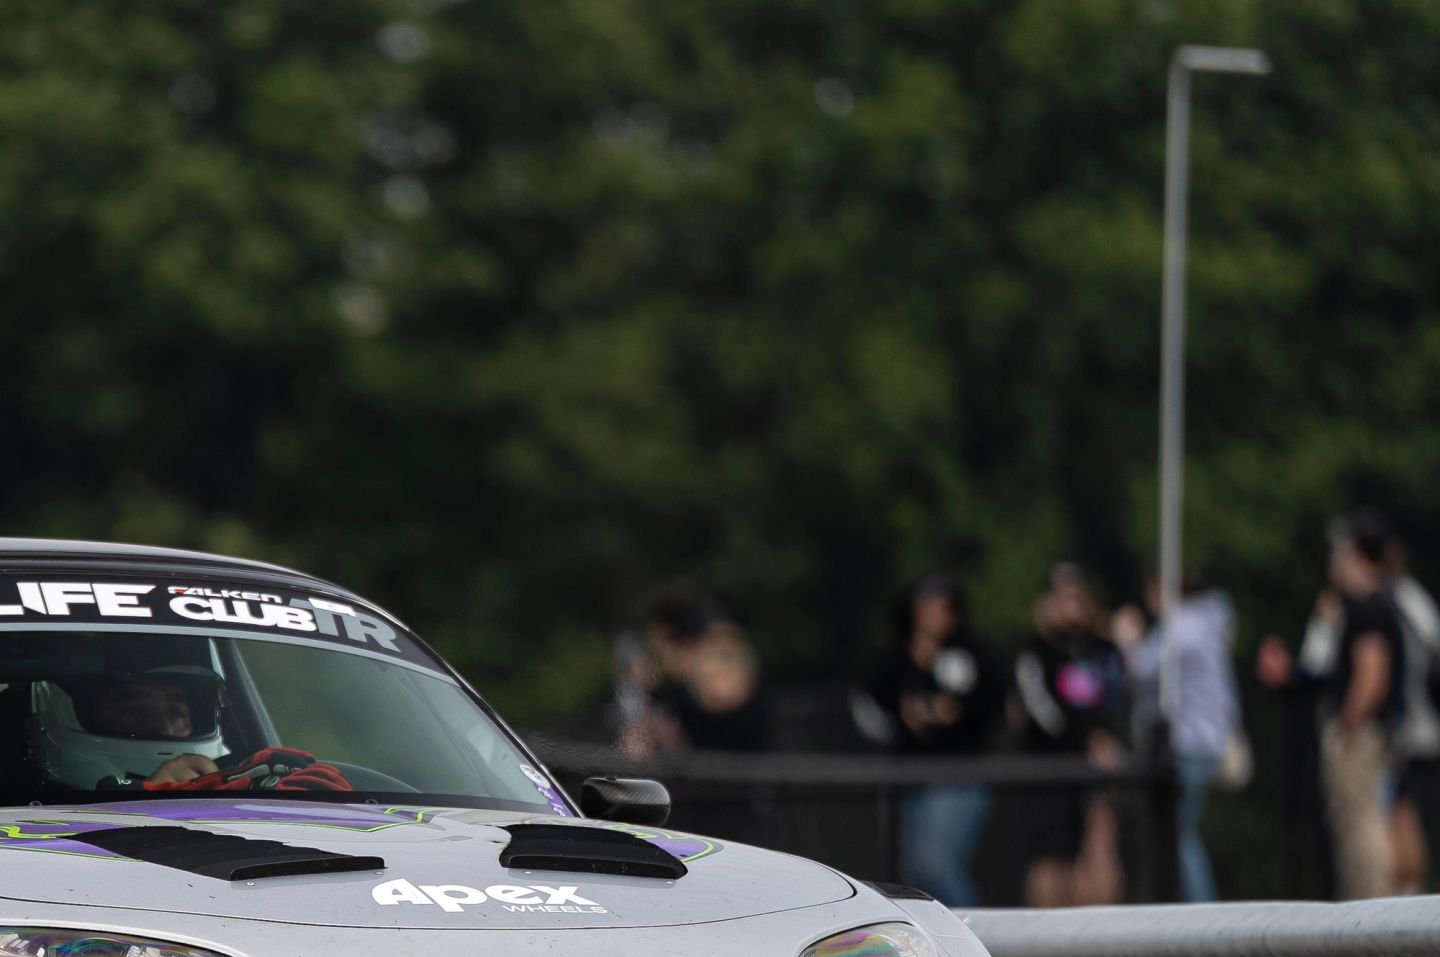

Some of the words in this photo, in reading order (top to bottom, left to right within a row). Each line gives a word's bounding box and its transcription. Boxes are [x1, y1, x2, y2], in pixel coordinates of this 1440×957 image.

[168, 585, 282, 604] FALKEN
[371, 878, 600, 912] Apex
[501, 904, 608, 914] WHEELS
